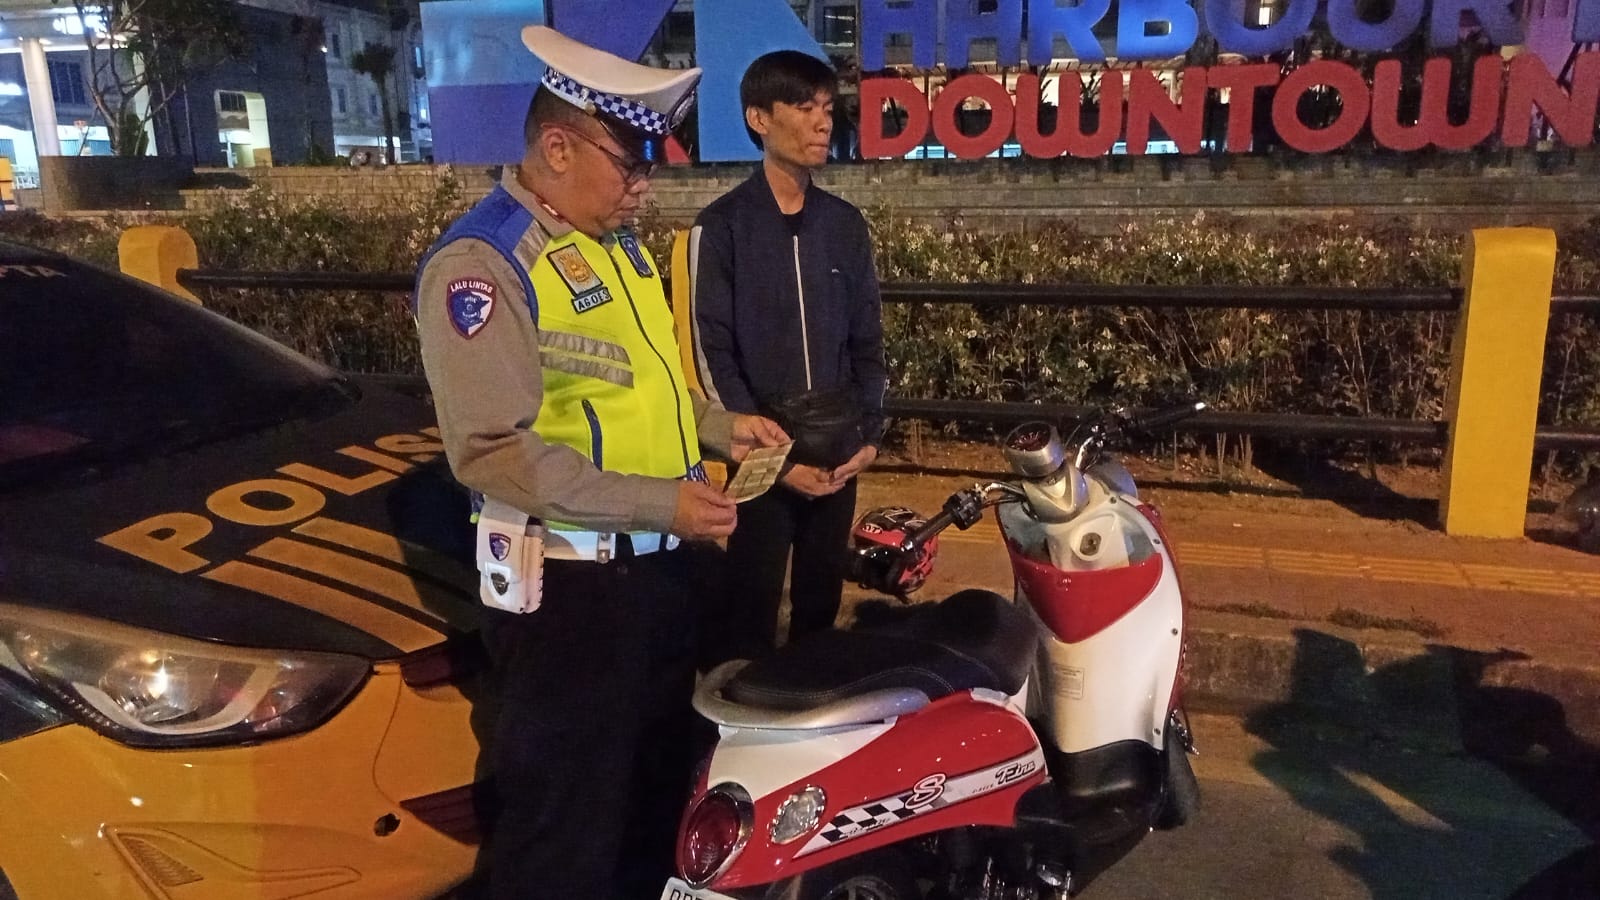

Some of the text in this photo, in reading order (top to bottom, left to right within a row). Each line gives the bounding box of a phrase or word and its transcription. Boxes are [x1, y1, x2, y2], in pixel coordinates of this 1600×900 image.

[859, 52, 1600, 160] DOWNTOWN
[450, 281, 494, 294] LALU LINTAS
[576, 289, 611, 311] AGOES
[95, 426, 447, 574] POLIS
